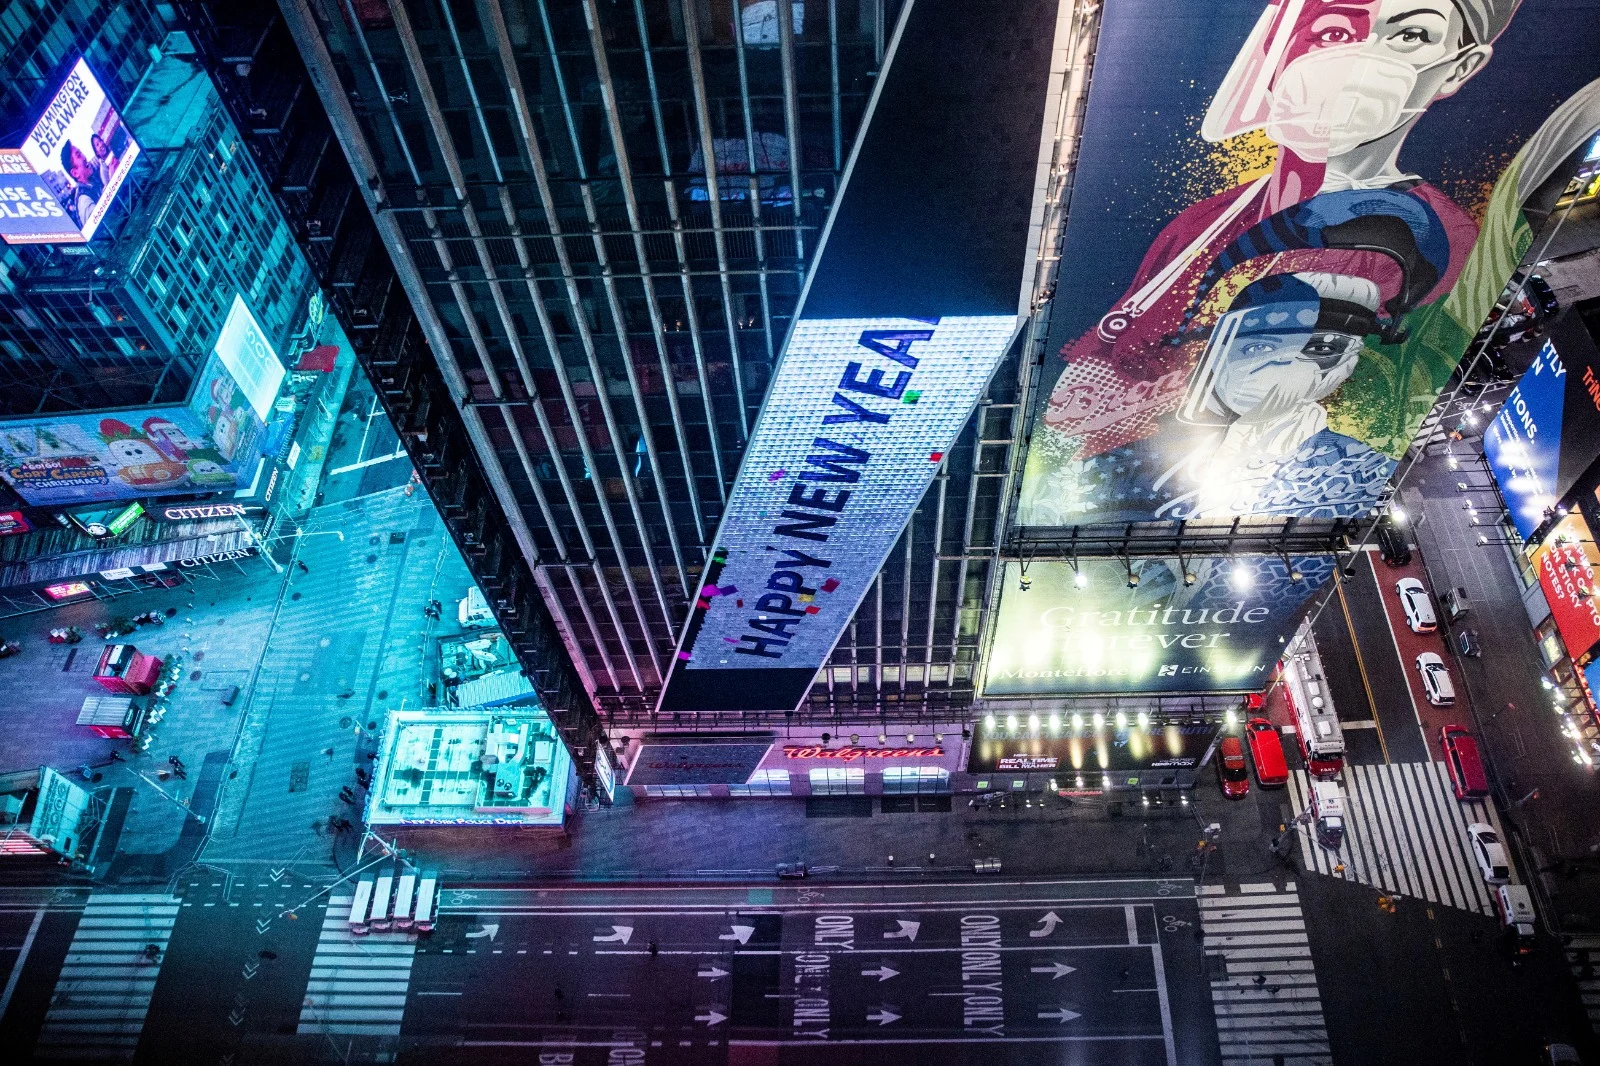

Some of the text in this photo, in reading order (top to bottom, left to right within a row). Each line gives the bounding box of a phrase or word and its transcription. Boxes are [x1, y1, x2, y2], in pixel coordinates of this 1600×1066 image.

[30, 70, 81, 144] WILMINGTON
[39, 80, 90, 158] DELAWARE
[0, 163, 33, 174] ARE
[34, 186, 53, 201] A
[35, 478, 99, 488] CHRISTMAS
[265, 466, 279, 502] CITIZEN
[735, 315, 942, 659] HAPPY NEW YEA
[164, 504, 246, 520] CITIZEN
[180, 550, 250, 567] CITIZEN
[1541, 550, 1565, 600] NOTES?
[1550, 543, 1582, 609] ON STICKY
[1040, 600, 1270, 629] Gratitude
[1000, 667, 1130, 681] Montefiore
[1181, 664, 1266, 676] EINSTEIN
[783, 743, 946, 763] Walgreens
[400, 816, 525, 825] NEW YORK POLICE DEPT
[814, 915, 854, 950] ONLY
[960, 915, 1001, 949] ONLY
[961, 951, 1003, 992] ONLY
[793, 998, 830, 1039] ONLY
[963, 996, 1005, 1036] ONLY
